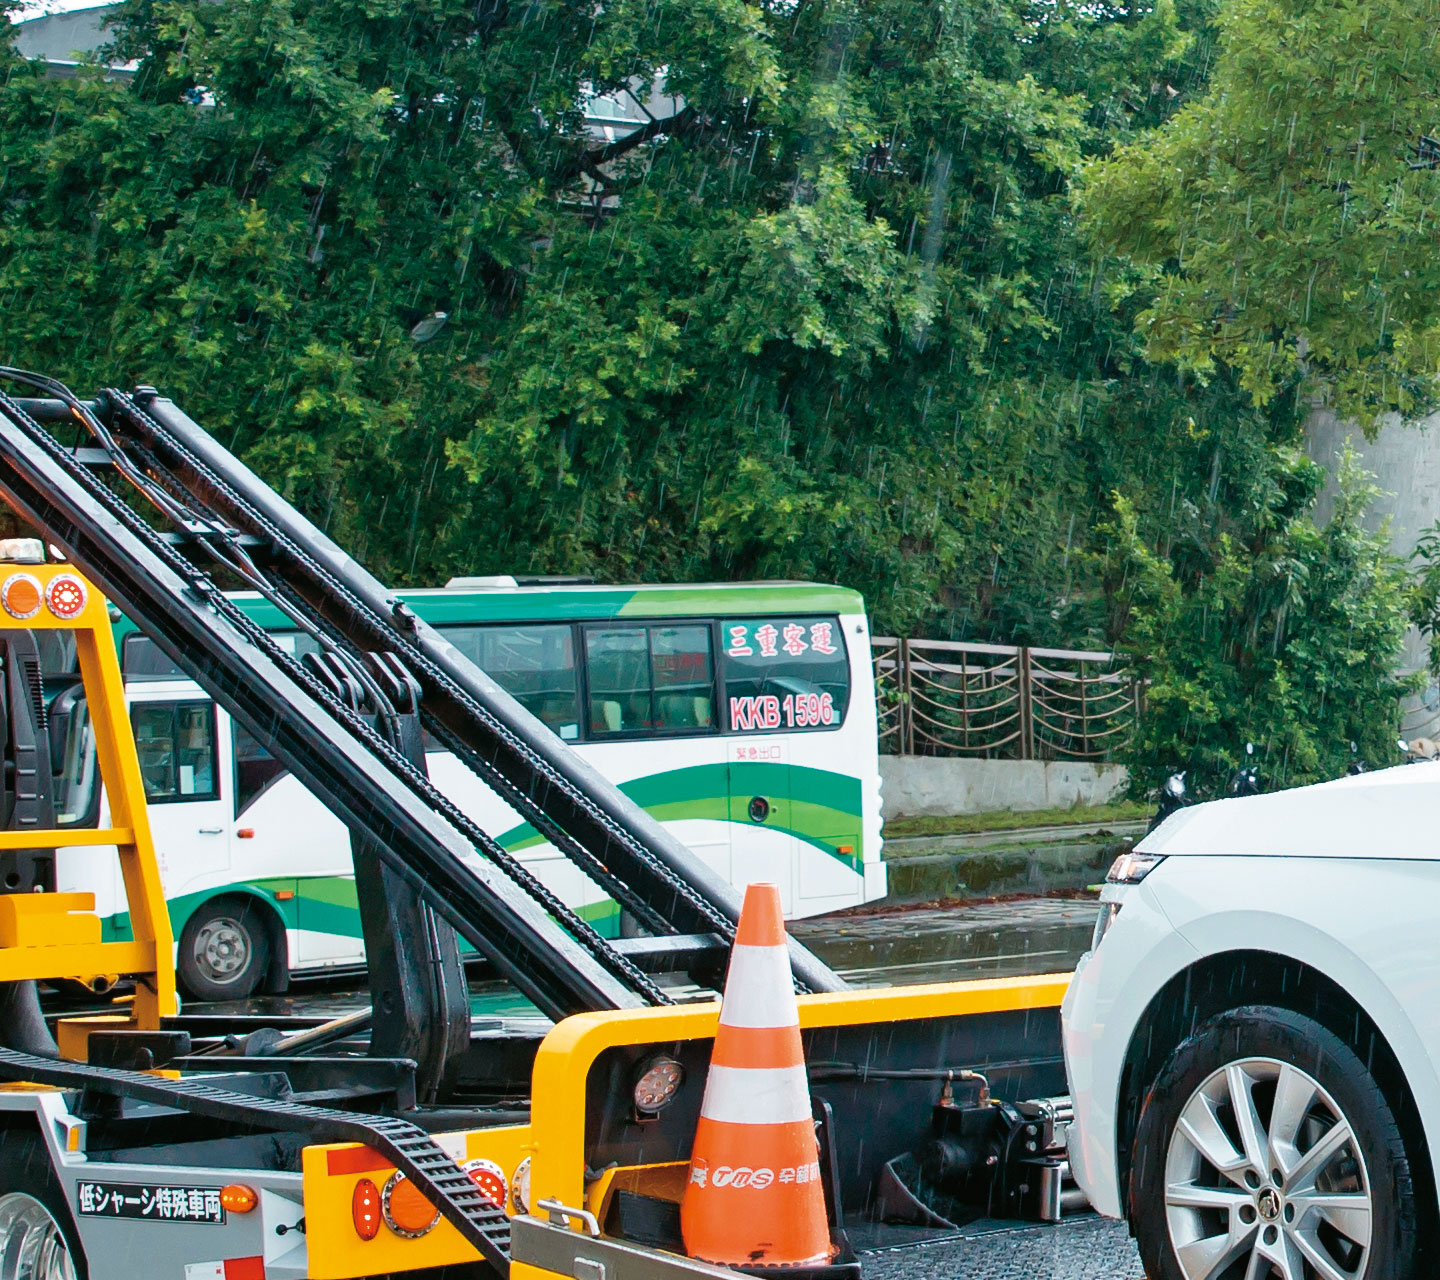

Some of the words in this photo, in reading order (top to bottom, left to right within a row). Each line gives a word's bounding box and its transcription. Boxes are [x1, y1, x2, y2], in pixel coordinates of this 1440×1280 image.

[728, 621, 838, 657] 三重客運
[729, 695, 781, 731] KKB
[782, 692, 833, 728] 1596
[714, 1168, 773, 1187] TMS
[79, 1183, 222, 1222] 低シャーシ特殊車両
